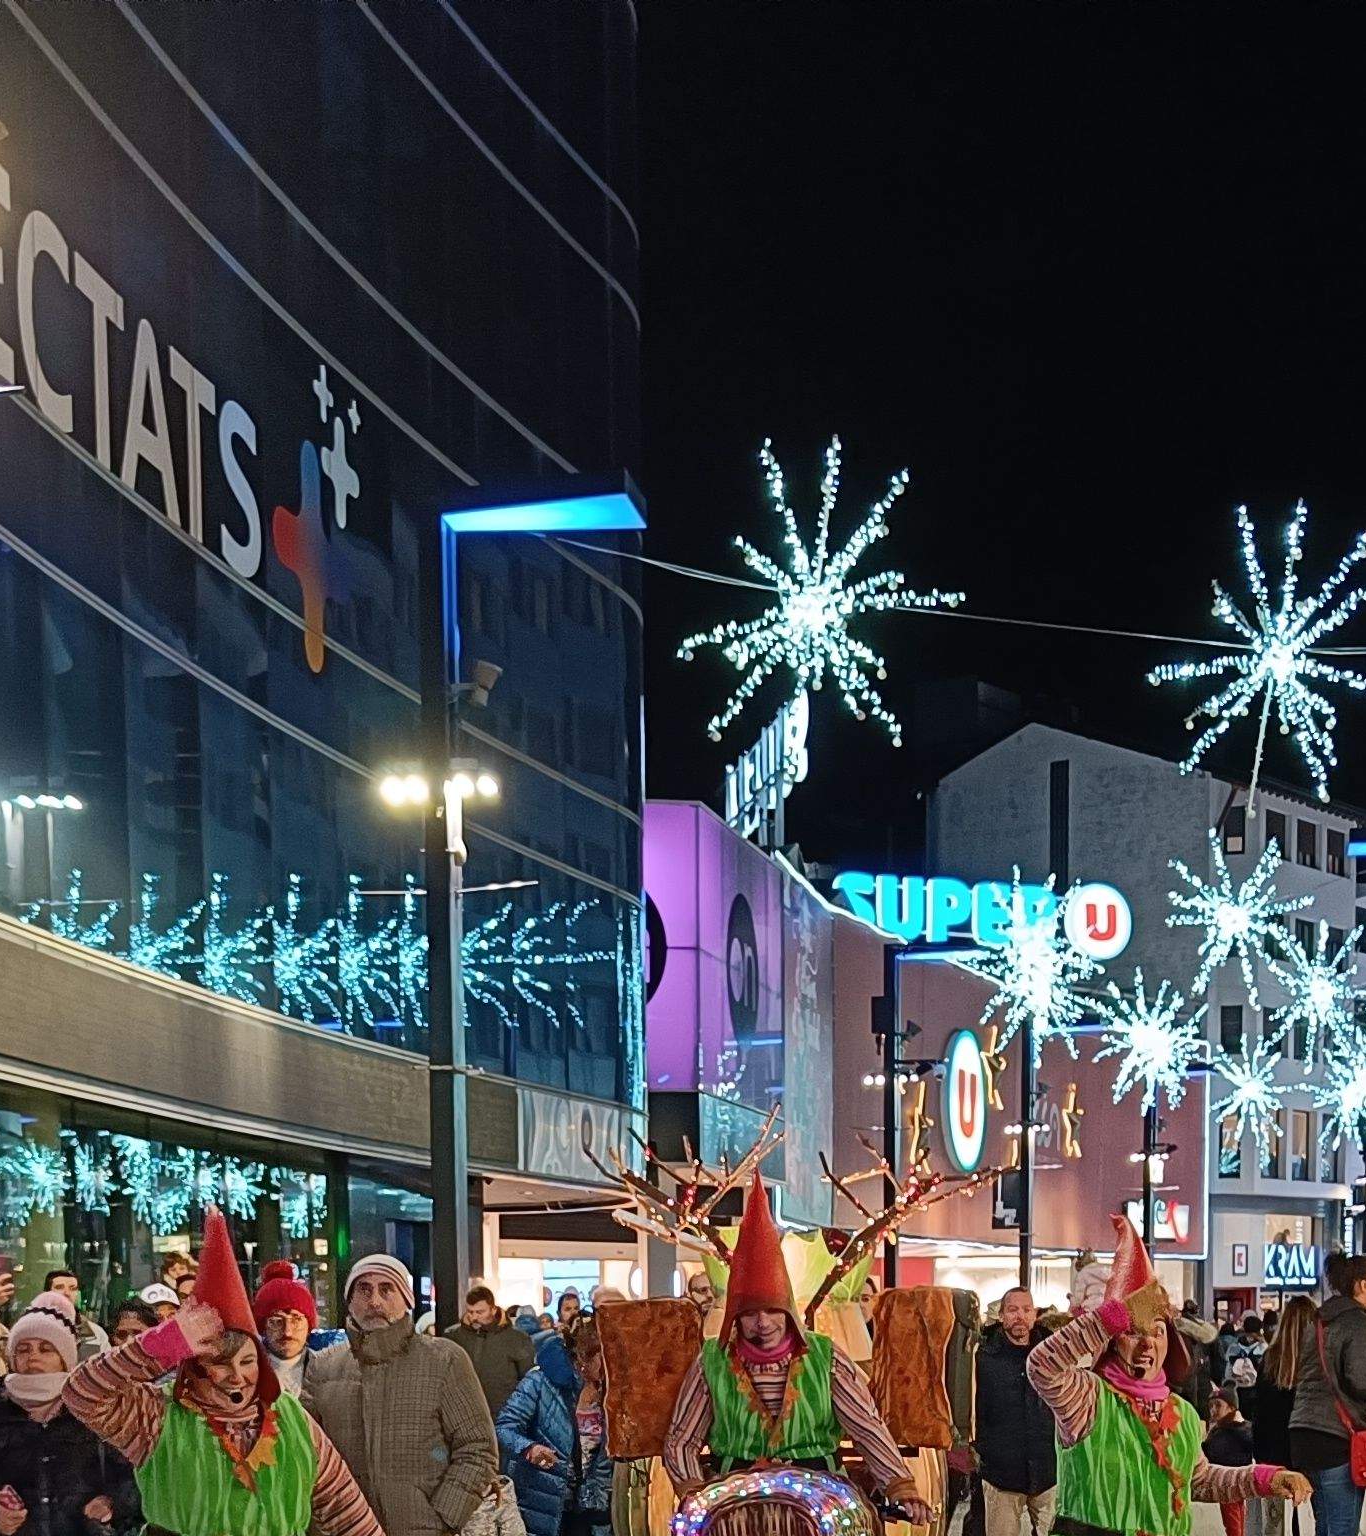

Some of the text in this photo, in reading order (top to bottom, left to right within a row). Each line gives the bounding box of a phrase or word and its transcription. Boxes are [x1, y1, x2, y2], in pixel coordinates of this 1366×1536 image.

[1086, 903, 1117, 941] U
[958, 1068, 977, 1138] U
[1264, 1243, 1315, 1277] KRAM
